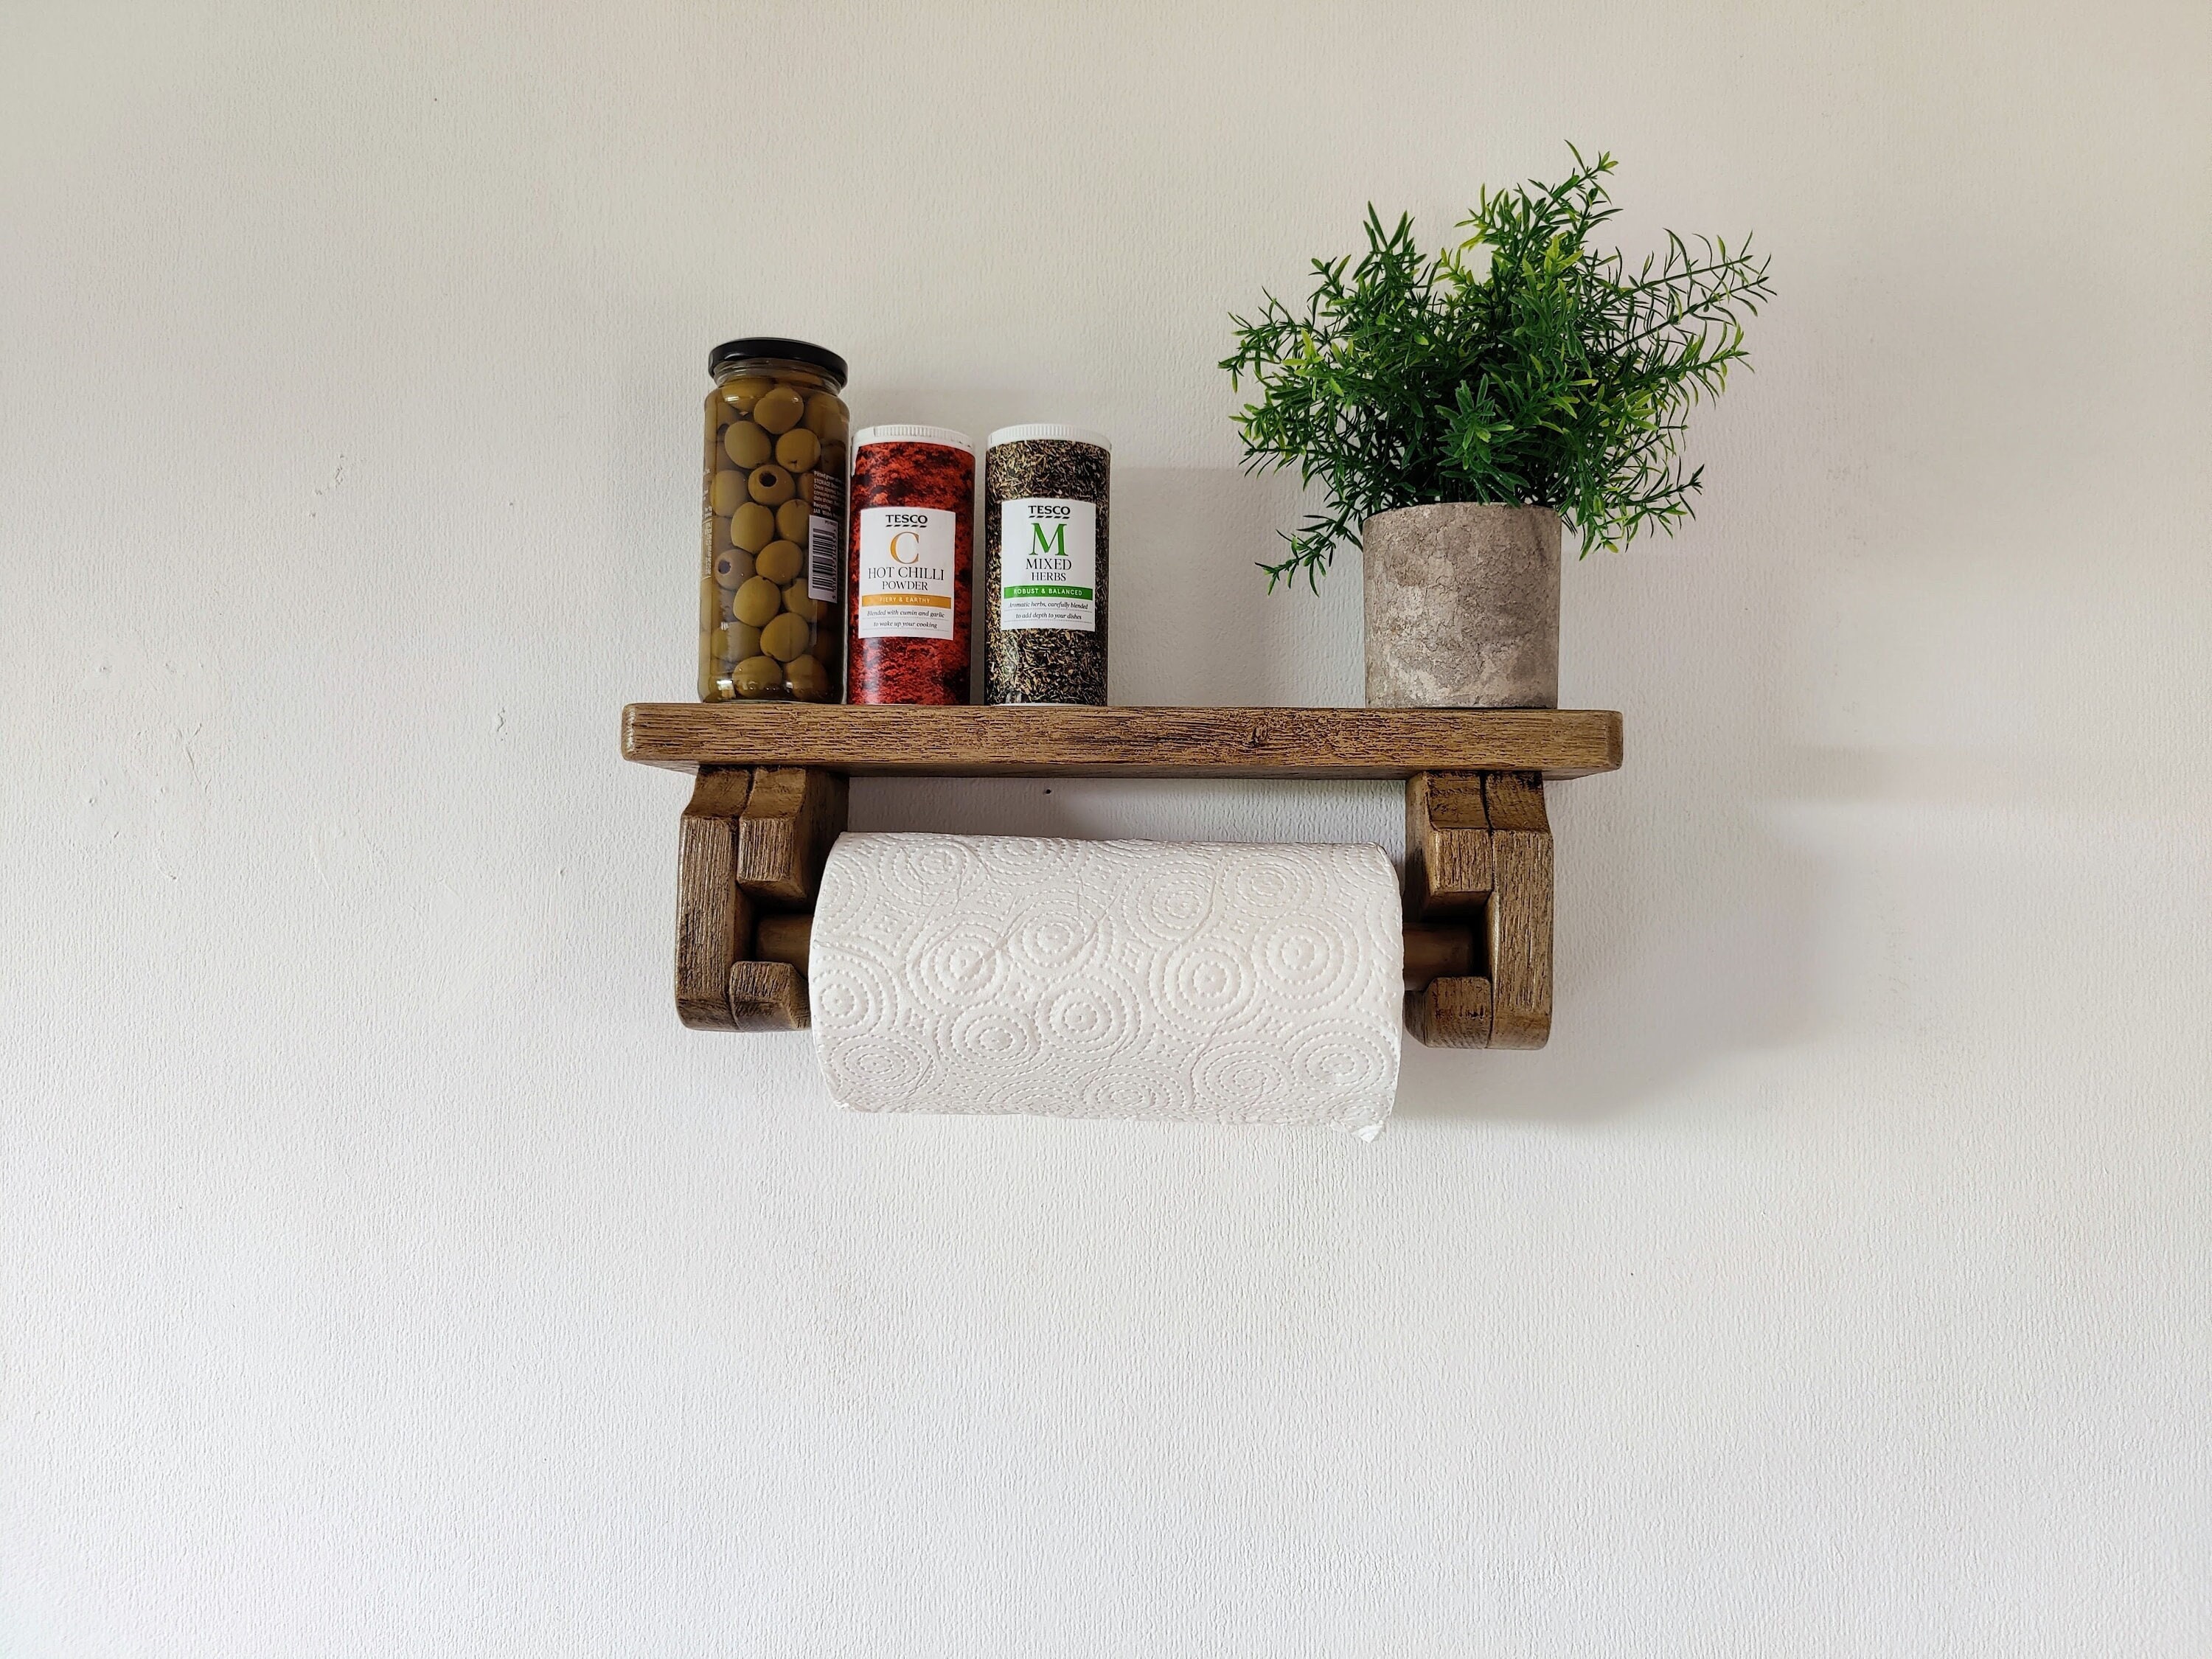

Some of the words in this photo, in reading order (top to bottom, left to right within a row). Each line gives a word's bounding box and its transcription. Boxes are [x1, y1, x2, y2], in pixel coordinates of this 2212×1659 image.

[1028, 505, 1071, 515] TESCO
[886, 515, 928, 524] TESCO
[1029, 523, 1068, 557] M
[890, 532, 919, 564] C
[1026, 558, 1071, 571] MIXED
[869, 566, 895, 579] HOT
[898, 566, 944, 580] CHILLI
[1032, 572, 1066, 581] HERBS
[883, 581, 928, 591] POWDER
[1071, 602, 1088, 610] blended
[917, 620, 938, 629] cooking
